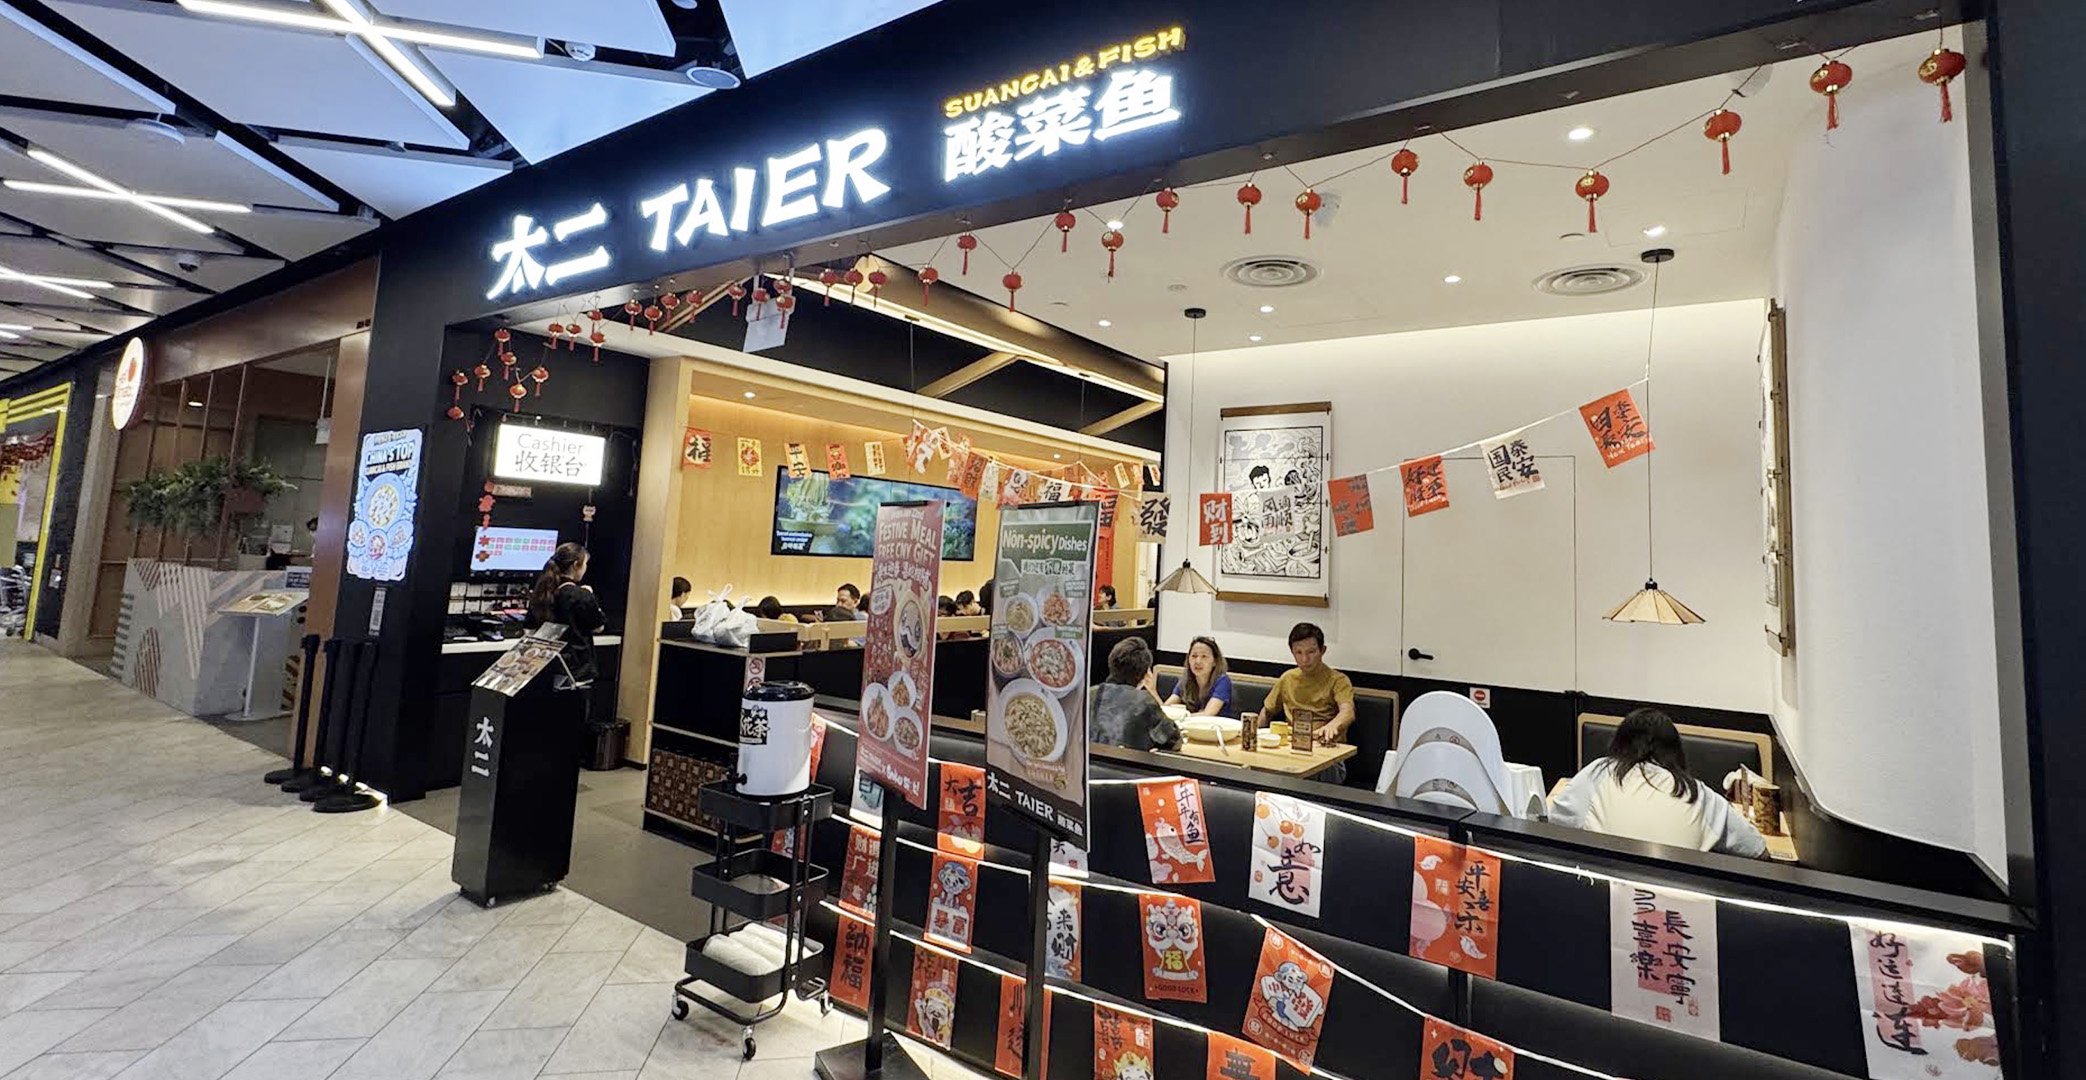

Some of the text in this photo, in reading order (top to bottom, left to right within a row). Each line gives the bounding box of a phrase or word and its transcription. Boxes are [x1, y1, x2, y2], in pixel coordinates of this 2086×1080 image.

[944, 70, 1181, 183] 酸菜鱼
[486, 128, 892, 300] 太二 TAIER
[517, 433, 584, 455] Cashier
[687, 435, 711, 463] 福
[515, 450, 584, 477] 收银台
[879, 519, 937, 550] FESTIVE MEAL
[1203, 498, 1229, 544] 财到
[895, 542, 912, 559] CNY
[914, 543, 935, 566] GIFT
[1058, 536, 1088, 552] Dishes
[471, 715, 496, 779] 太二
[987, 771, 1012, 800] 太二
[1015, 790, 1054, 822] TAIER
[1057, 814, 1084, 836] 酸菜鱼
[1267, 840, 1322, 905] 如意
[1165, 950, 1184, 971] 福
